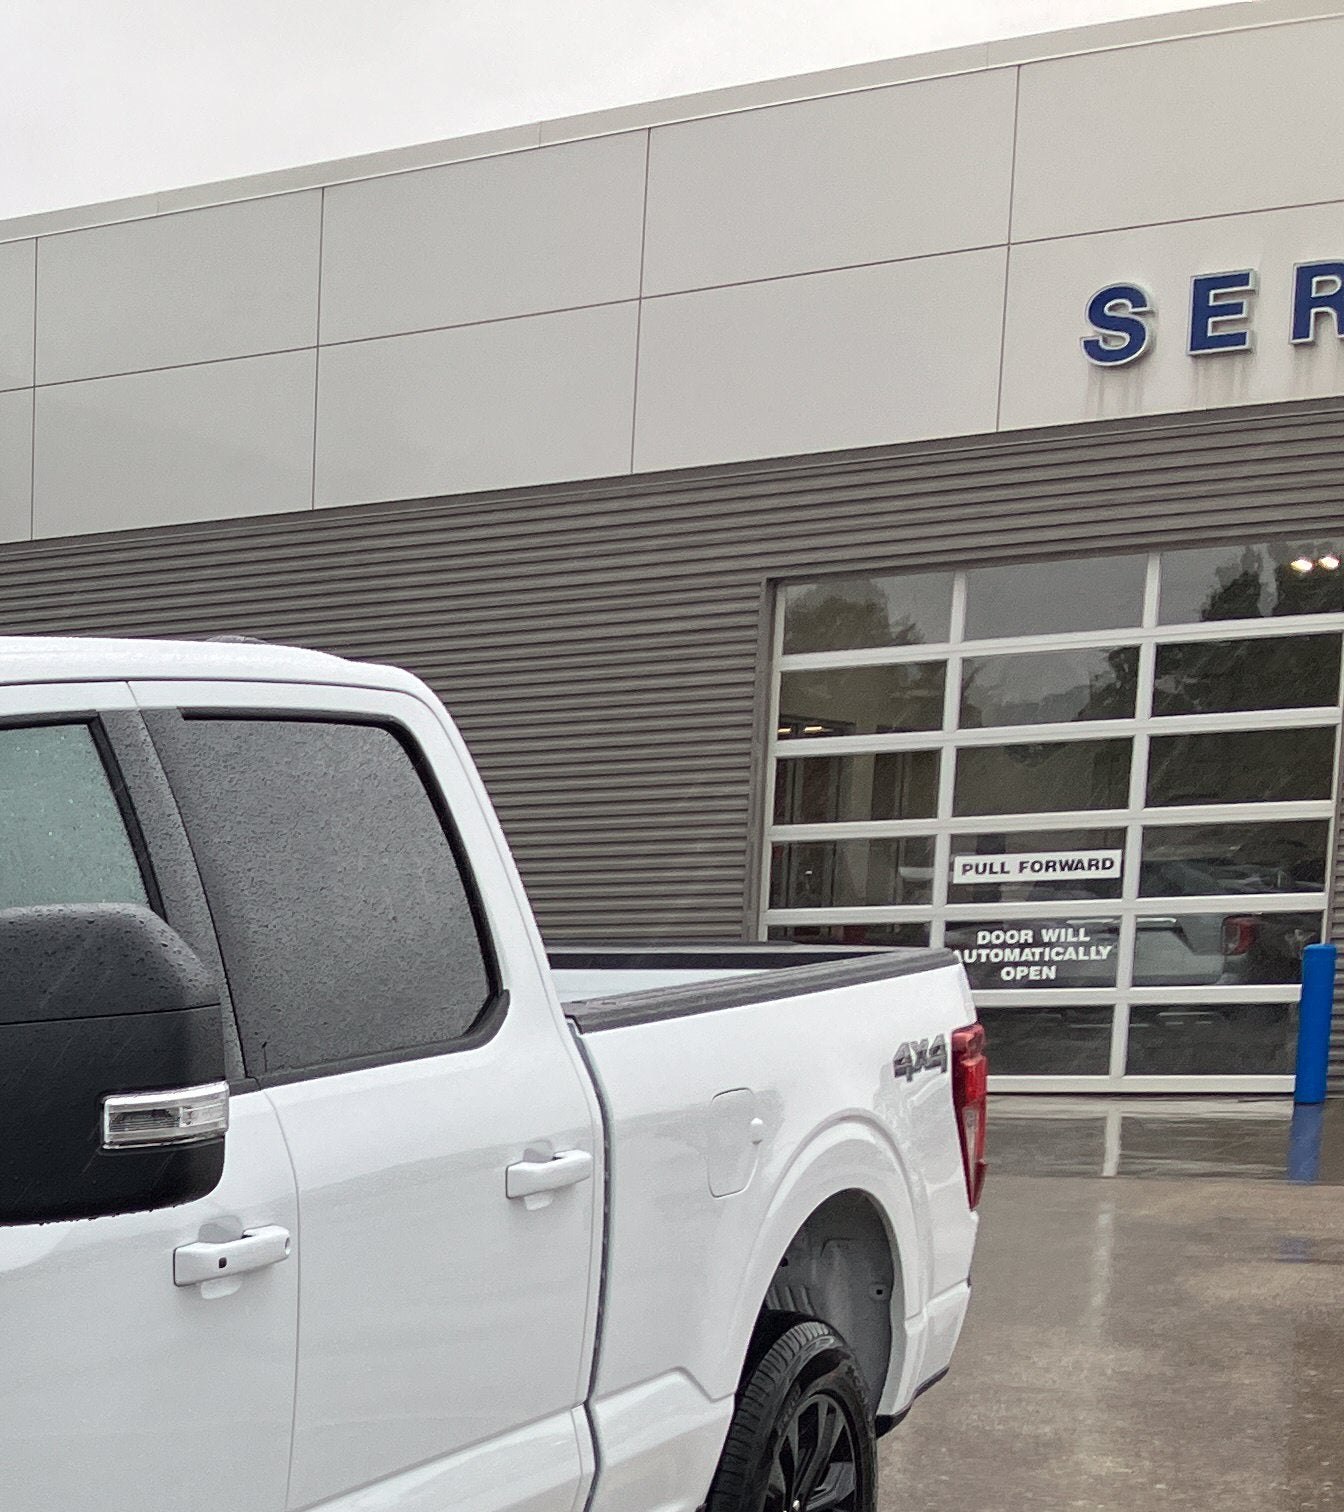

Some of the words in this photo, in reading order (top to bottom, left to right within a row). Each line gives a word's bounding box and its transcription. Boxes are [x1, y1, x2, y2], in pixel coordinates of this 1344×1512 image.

[1080, 258, 1344, 367] SER
[961, 862, 1010, 876] PULL
[1018, 857, 1115, 873] FORWARD
[976, 929, 1034, 945] DOOR
[1041, 927, 1091, 943] WILL
[1000, 965, 1057, 981] OPEN
